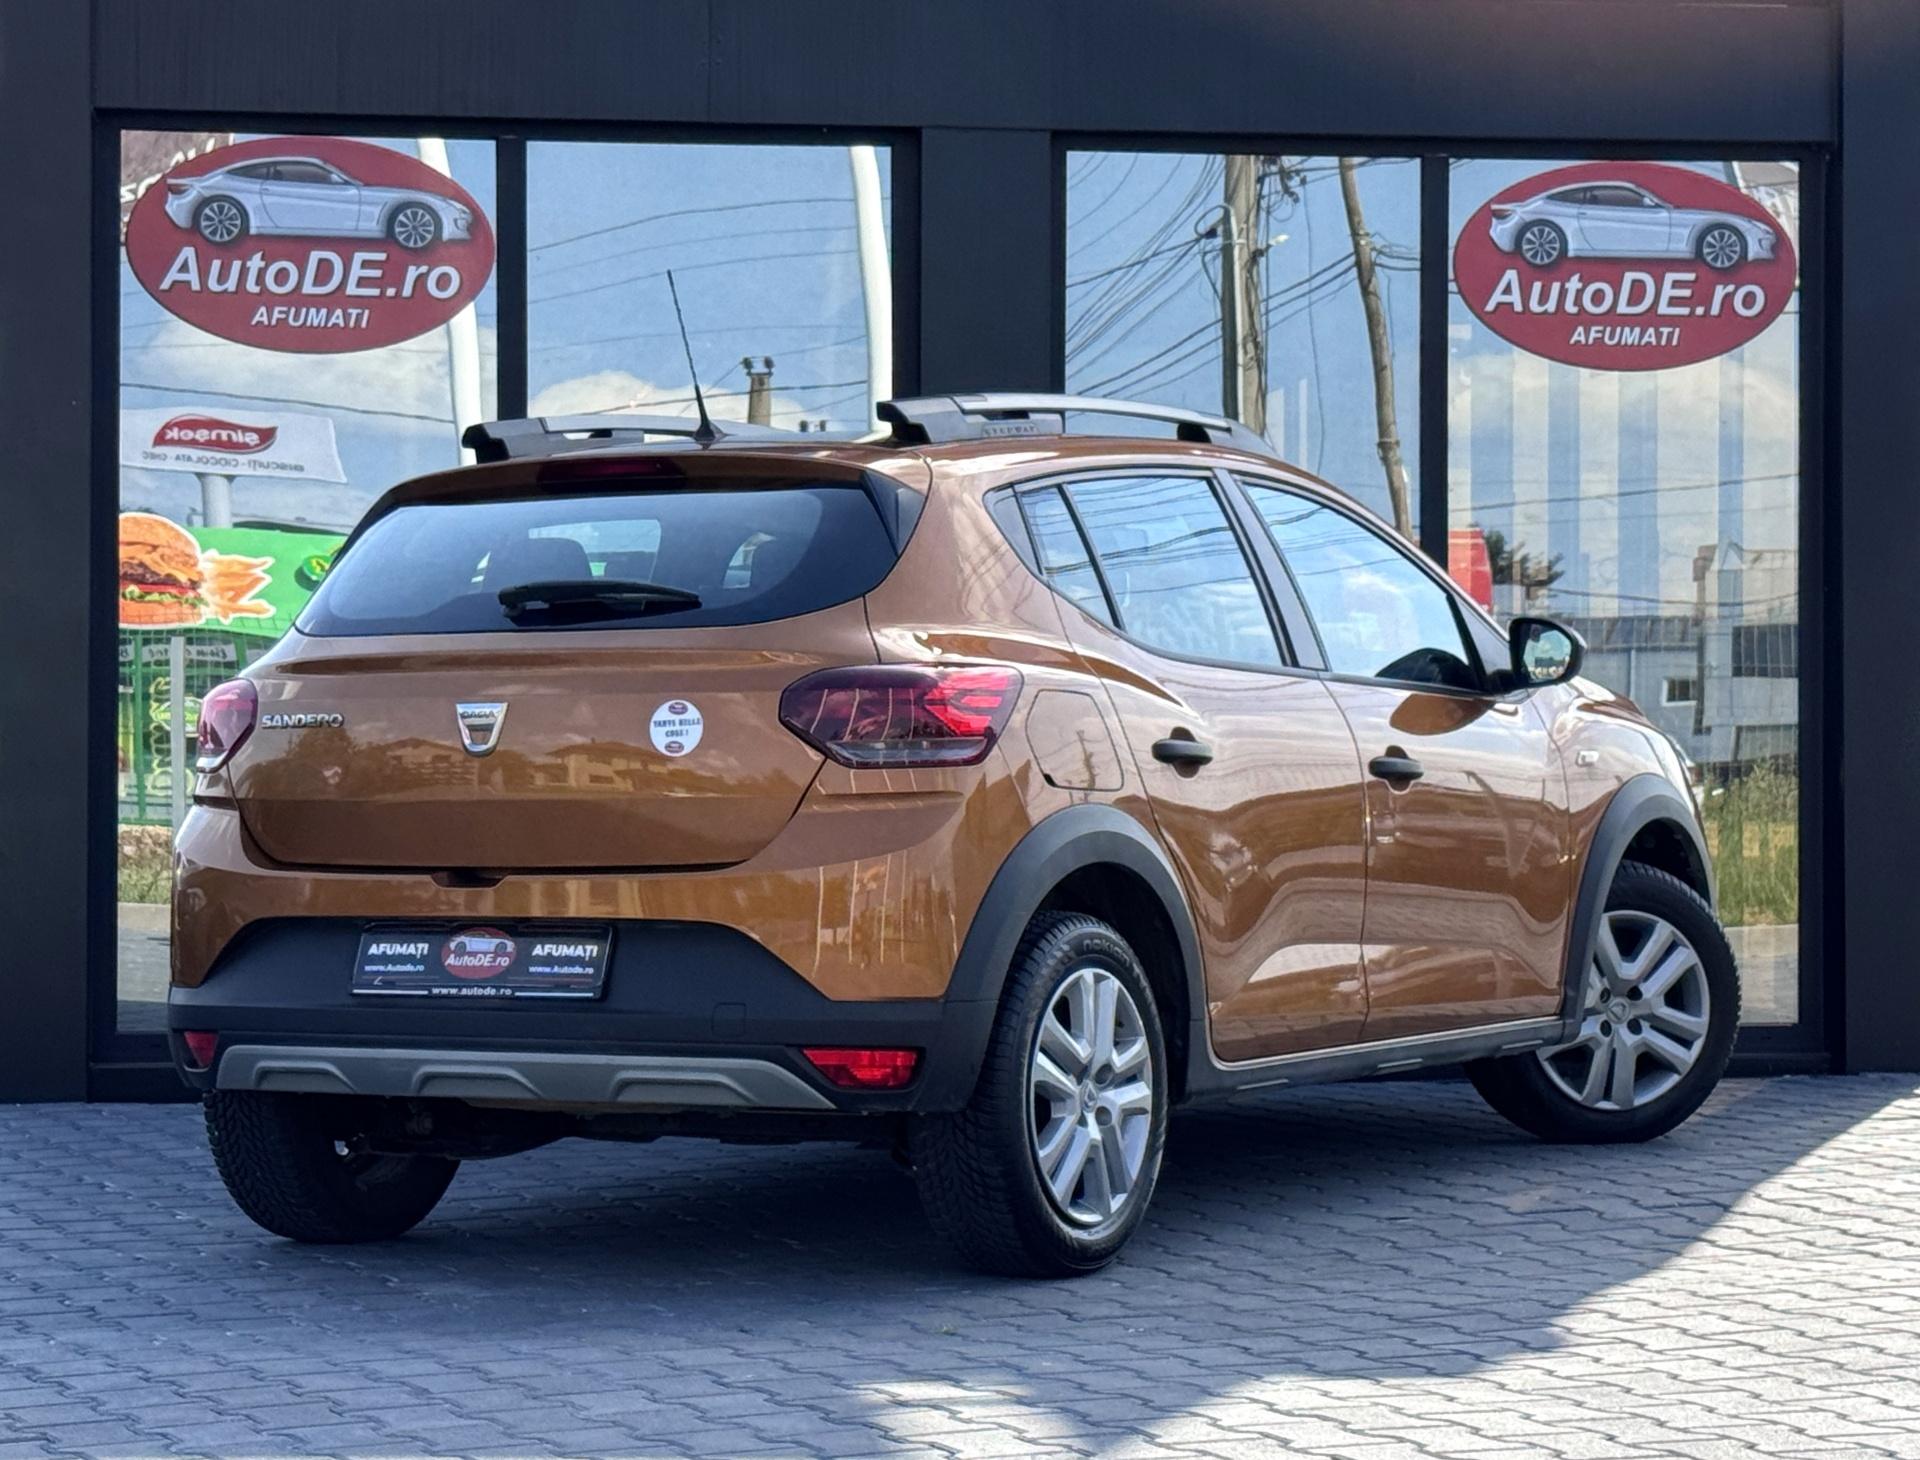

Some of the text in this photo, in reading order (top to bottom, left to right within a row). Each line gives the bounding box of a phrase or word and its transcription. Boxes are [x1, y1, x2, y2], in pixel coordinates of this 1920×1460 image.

[160, 246, 462, 300] AutoDE.ro
[1484, 269, 1766, 318] AutoDE.ro
[251, 306, 369, 329] AFUMATI
[1569, 326, 1680, 347] AFUMATI
[261, 712, 344, 728] SANDERO
[444, 953, 510, 967] AutoDE.ro
[431, 986, 513, 996] www.autode.ro
